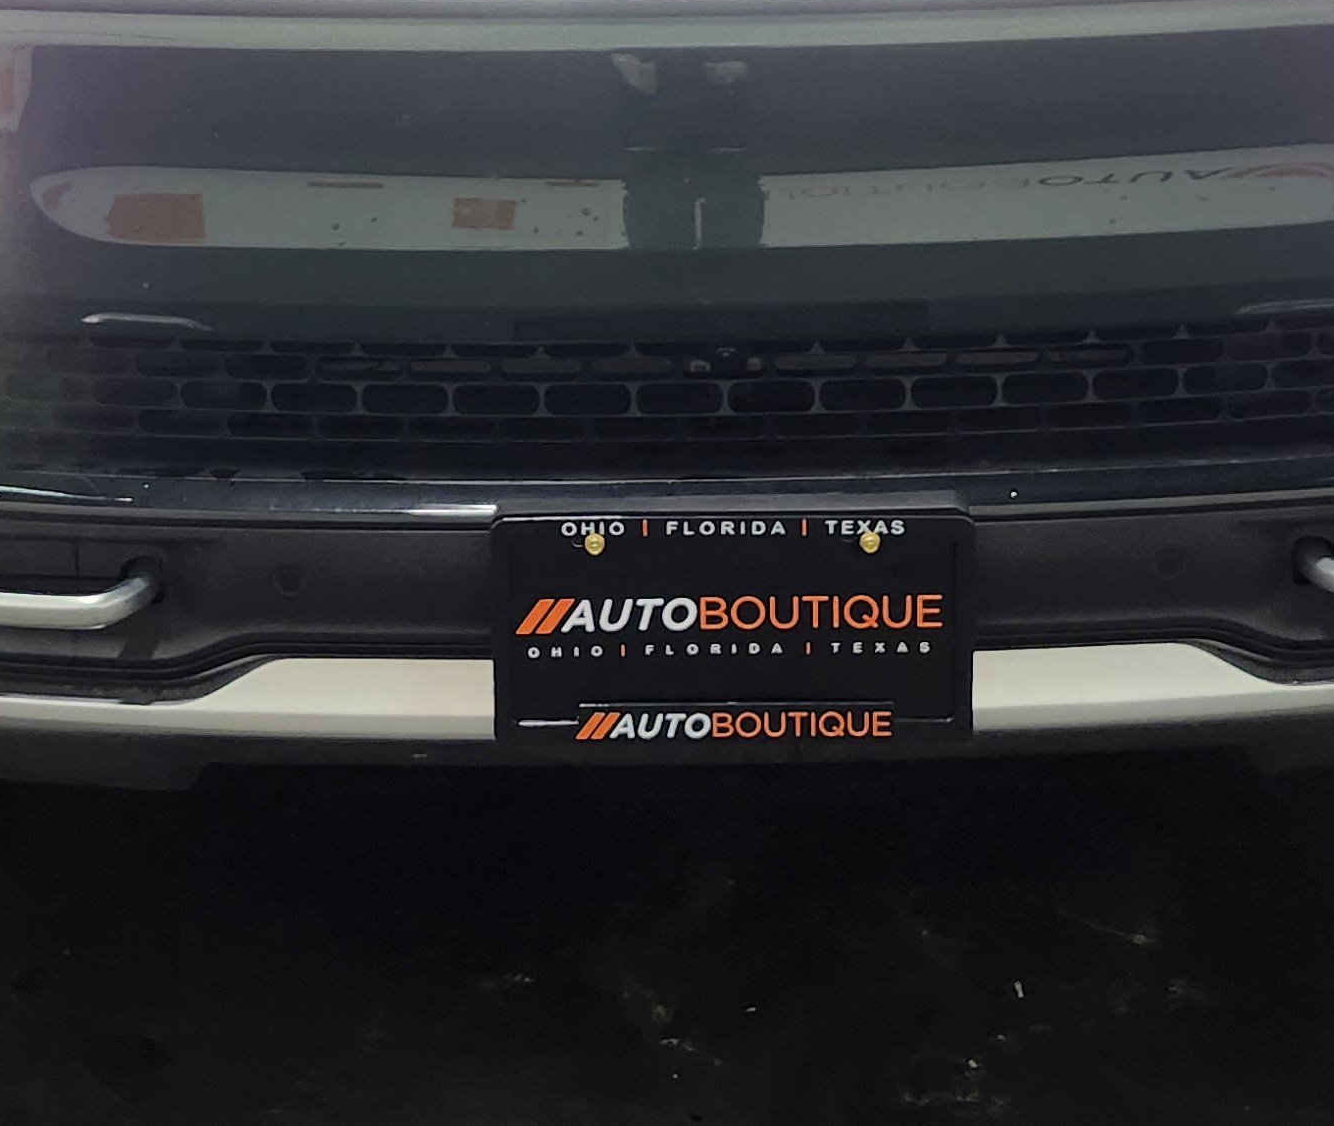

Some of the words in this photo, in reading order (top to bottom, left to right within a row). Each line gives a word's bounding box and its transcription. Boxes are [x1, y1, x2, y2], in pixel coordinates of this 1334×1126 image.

[561, 521, 625, 537] OHIO
[666, 520, 786, 536] FLORIDA
[825, 519, 905, 536] TEXAS
[560, 594, 944, 634] AUTOBOUTIQUE
[527, 645, 603, 658] OHIO
[644, 642, 783, 656] FLORIDA
[831, 641, 931, 655] TEXAS
[609, 711, 893, 740] AUTOBOUTIQUE
